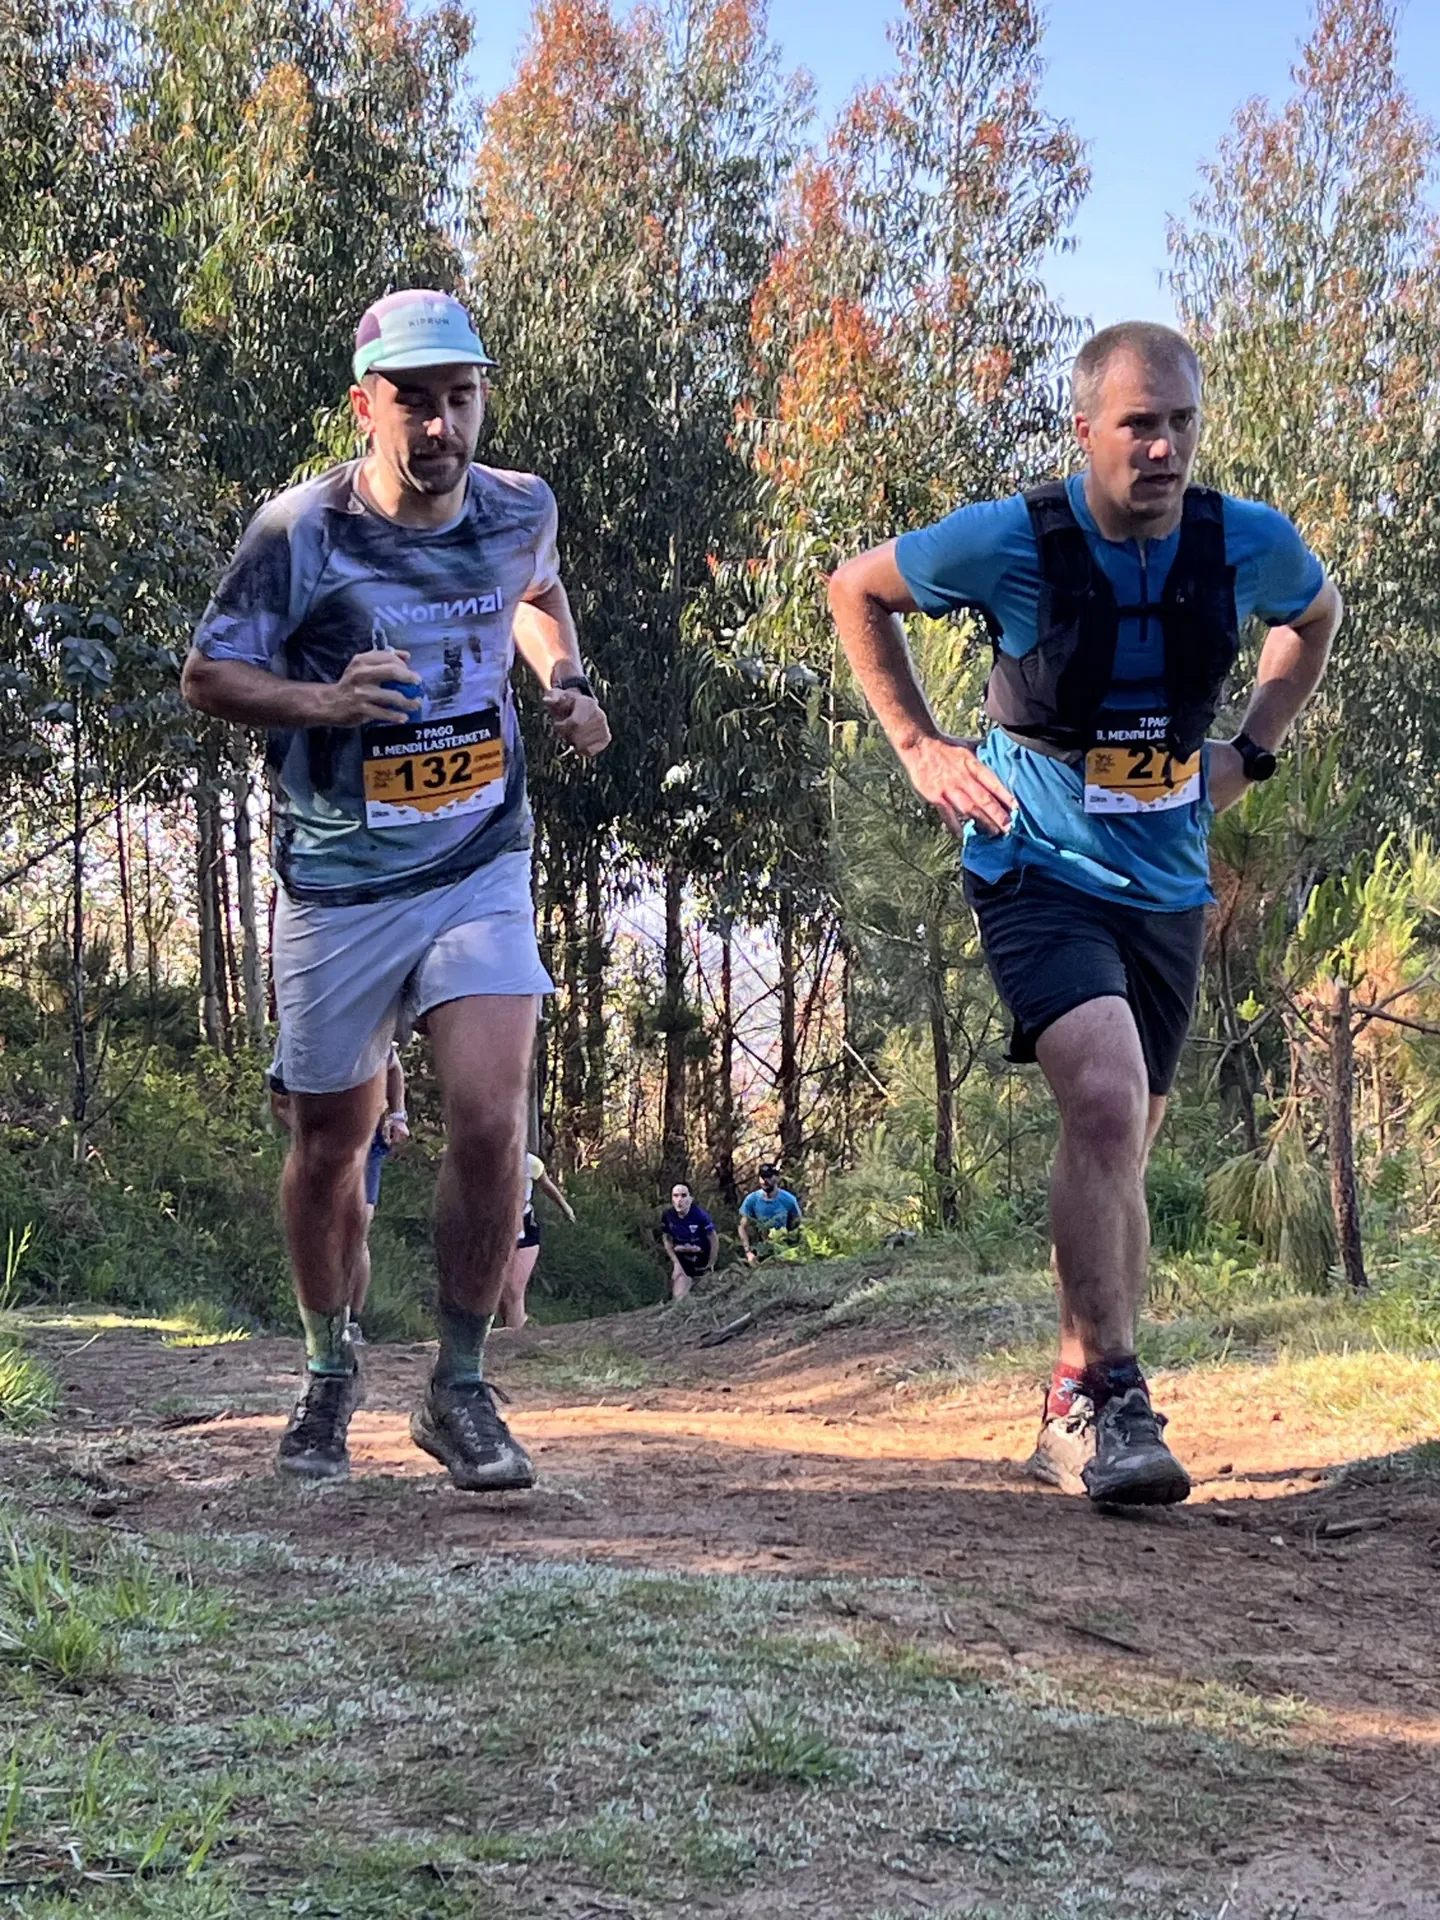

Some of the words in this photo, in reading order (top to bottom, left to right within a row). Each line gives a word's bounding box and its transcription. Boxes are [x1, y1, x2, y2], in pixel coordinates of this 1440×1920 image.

[1139, 717, 1147, 728] 7
[423, 724, 455, 739] PAGO
[1108, 729, 1145, 741] MENDI
[385, 741, 423, 756] MENDI
[423, 728, 492, 752] LASTERKETA
[394, 750, 473, 793] 132
